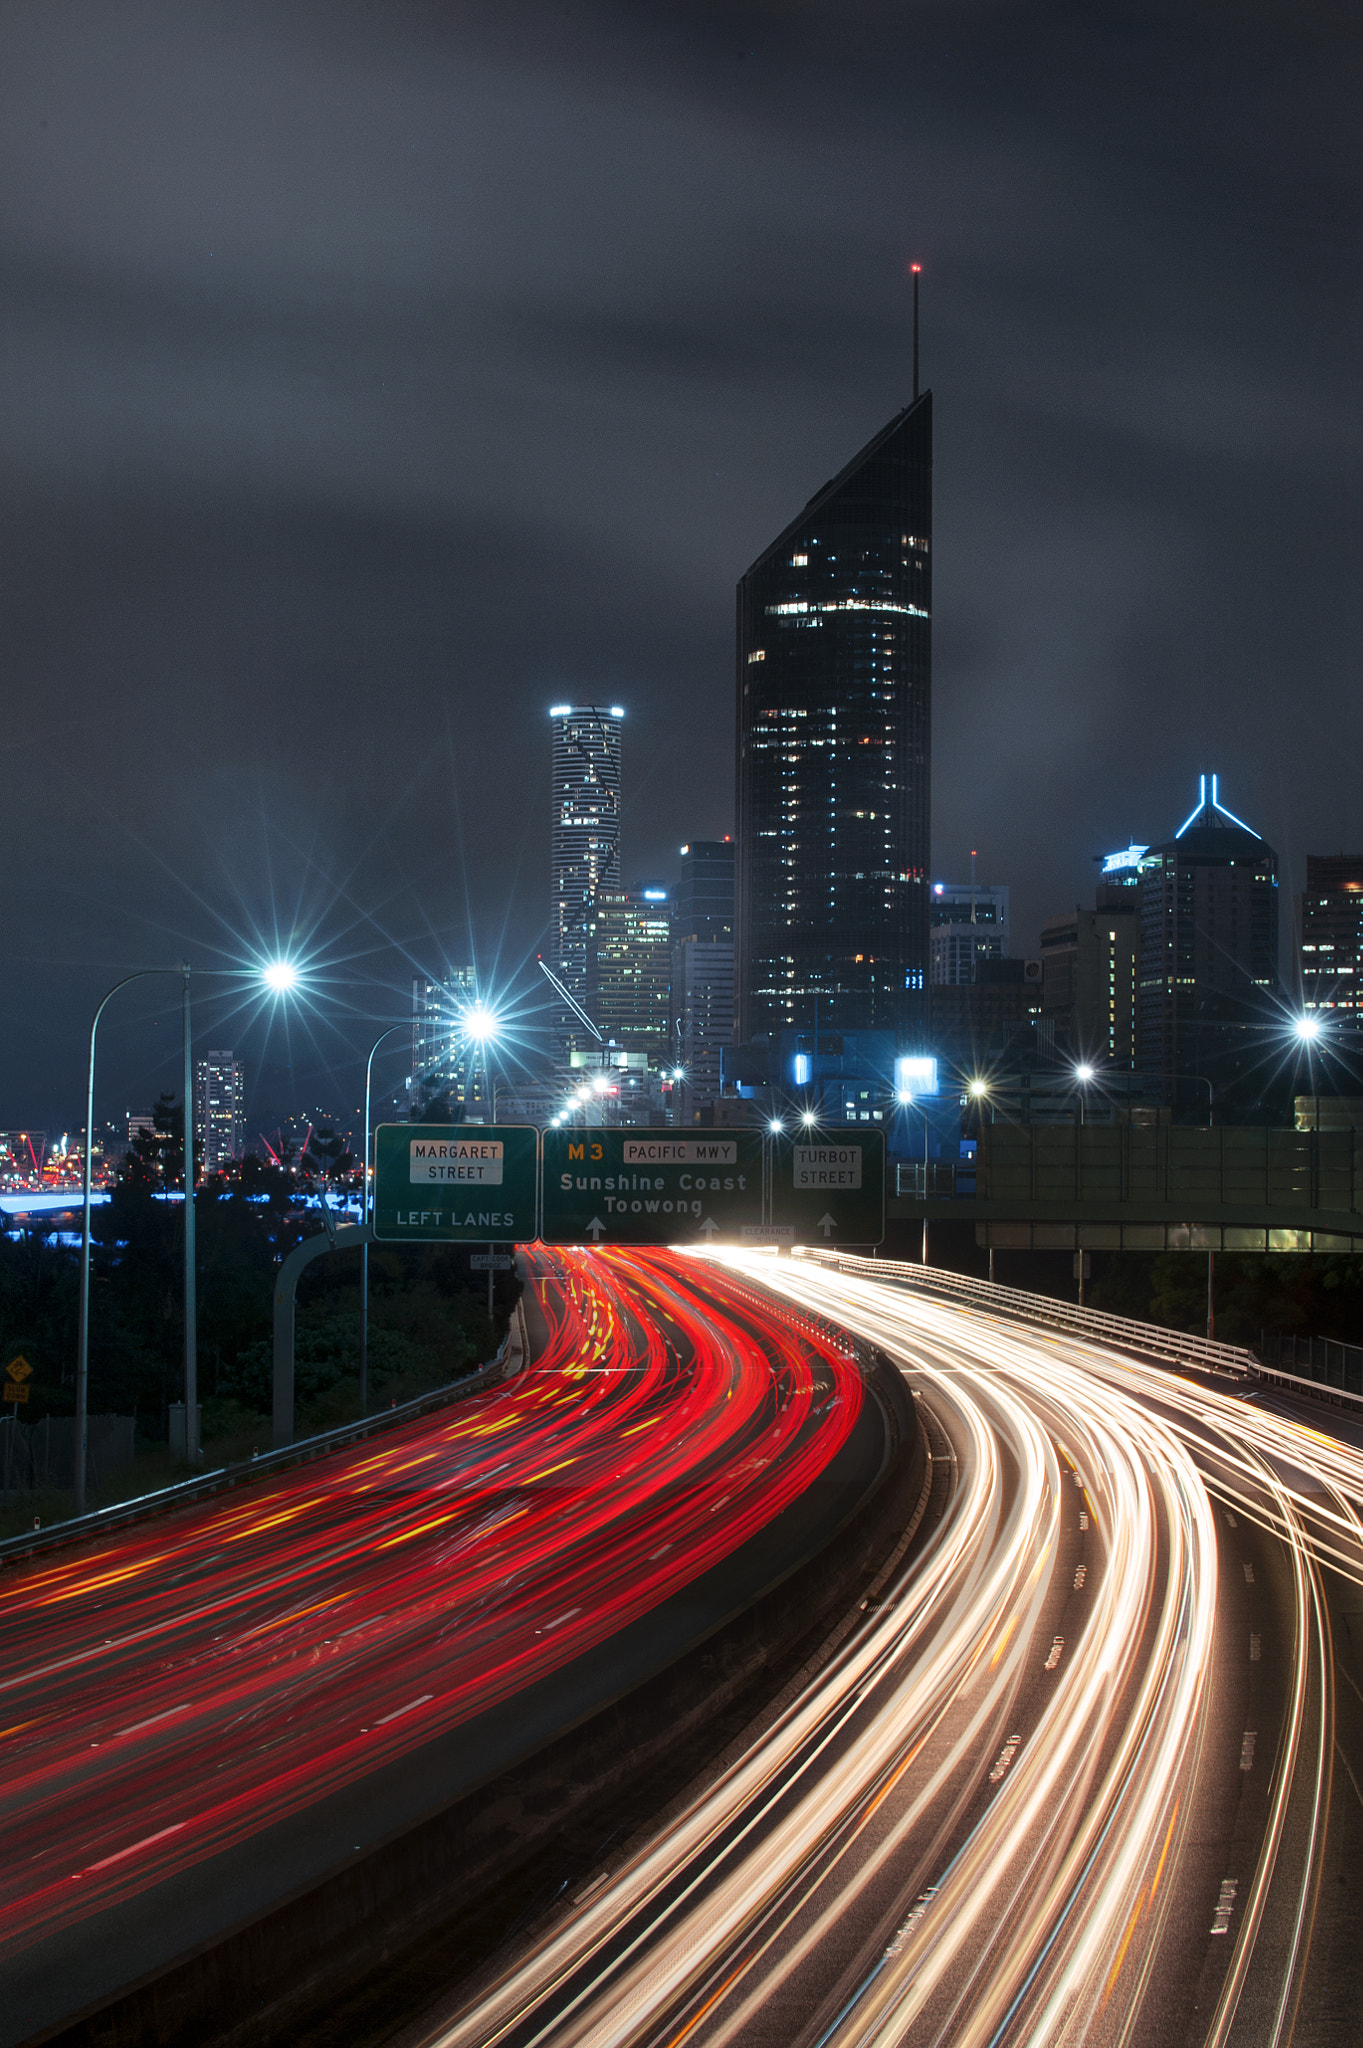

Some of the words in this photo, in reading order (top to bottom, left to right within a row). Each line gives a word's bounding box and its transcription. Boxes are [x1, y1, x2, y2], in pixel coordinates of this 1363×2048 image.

[415, 1145, 498, 1159] MARGARET
[629, 1145, 687, 1159] PACIFIC
[696, 1146, 731, 1159] MWY
[799, 1150, 857, 1163] TURBOT
[428, 1165, 485, 1179] STREET
[800, 1171, 855, 1184] STREET
[559, 1173, 665, 1191] Sunshine
[679, 1173, 746, 1191] Coast
[603, 1196, 703, 1218] Toowong
[396, 1211, 443, 1225] LEFT
[451, 1212, 514, 1227] LANES
[744, 1228, 791, 1236] CLEARANCE
